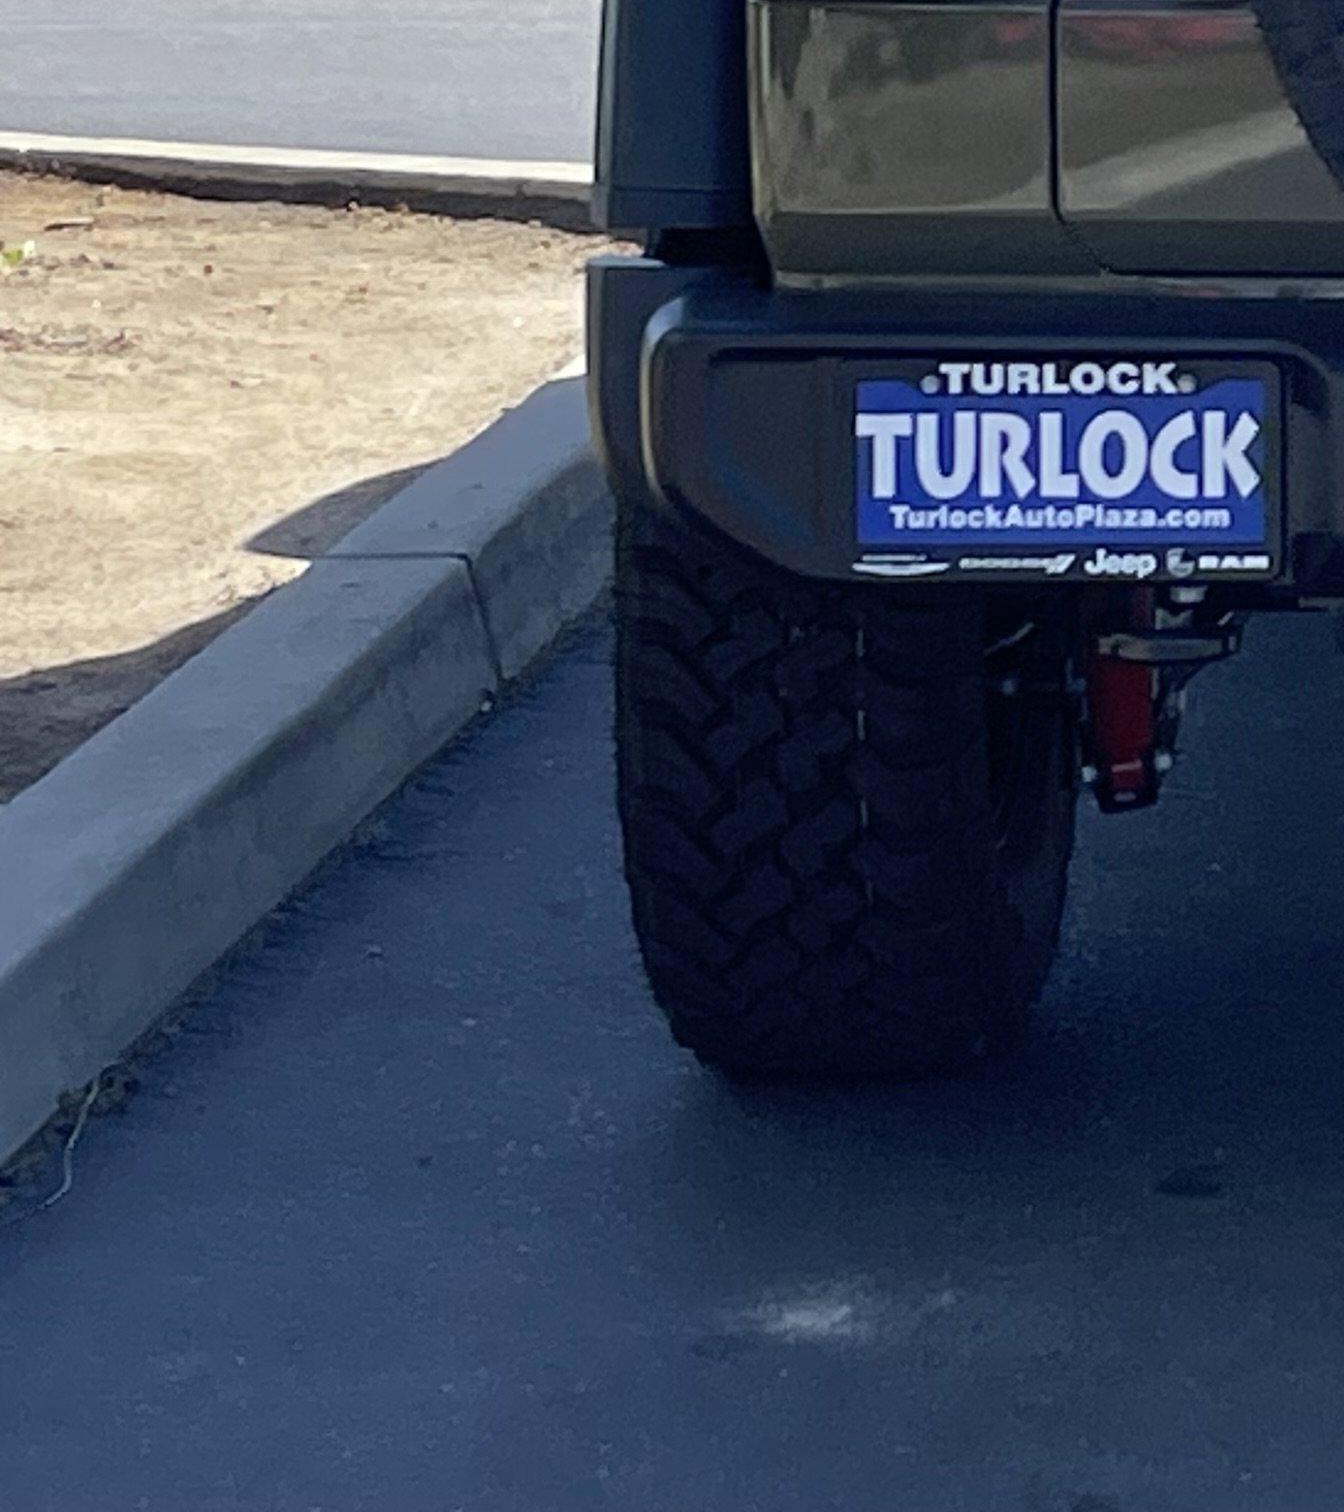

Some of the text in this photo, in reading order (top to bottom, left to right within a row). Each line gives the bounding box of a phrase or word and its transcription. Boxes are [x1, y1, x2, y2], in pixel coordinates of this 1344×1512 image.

[938, 362, 1177, 394] TURLOCK
[856, 410, 1260, 500] TURLOCK
[889, 504, 1231, 529] TurlockAutoPlaza.com
[1084, 548, 1157, 578] Jeep
